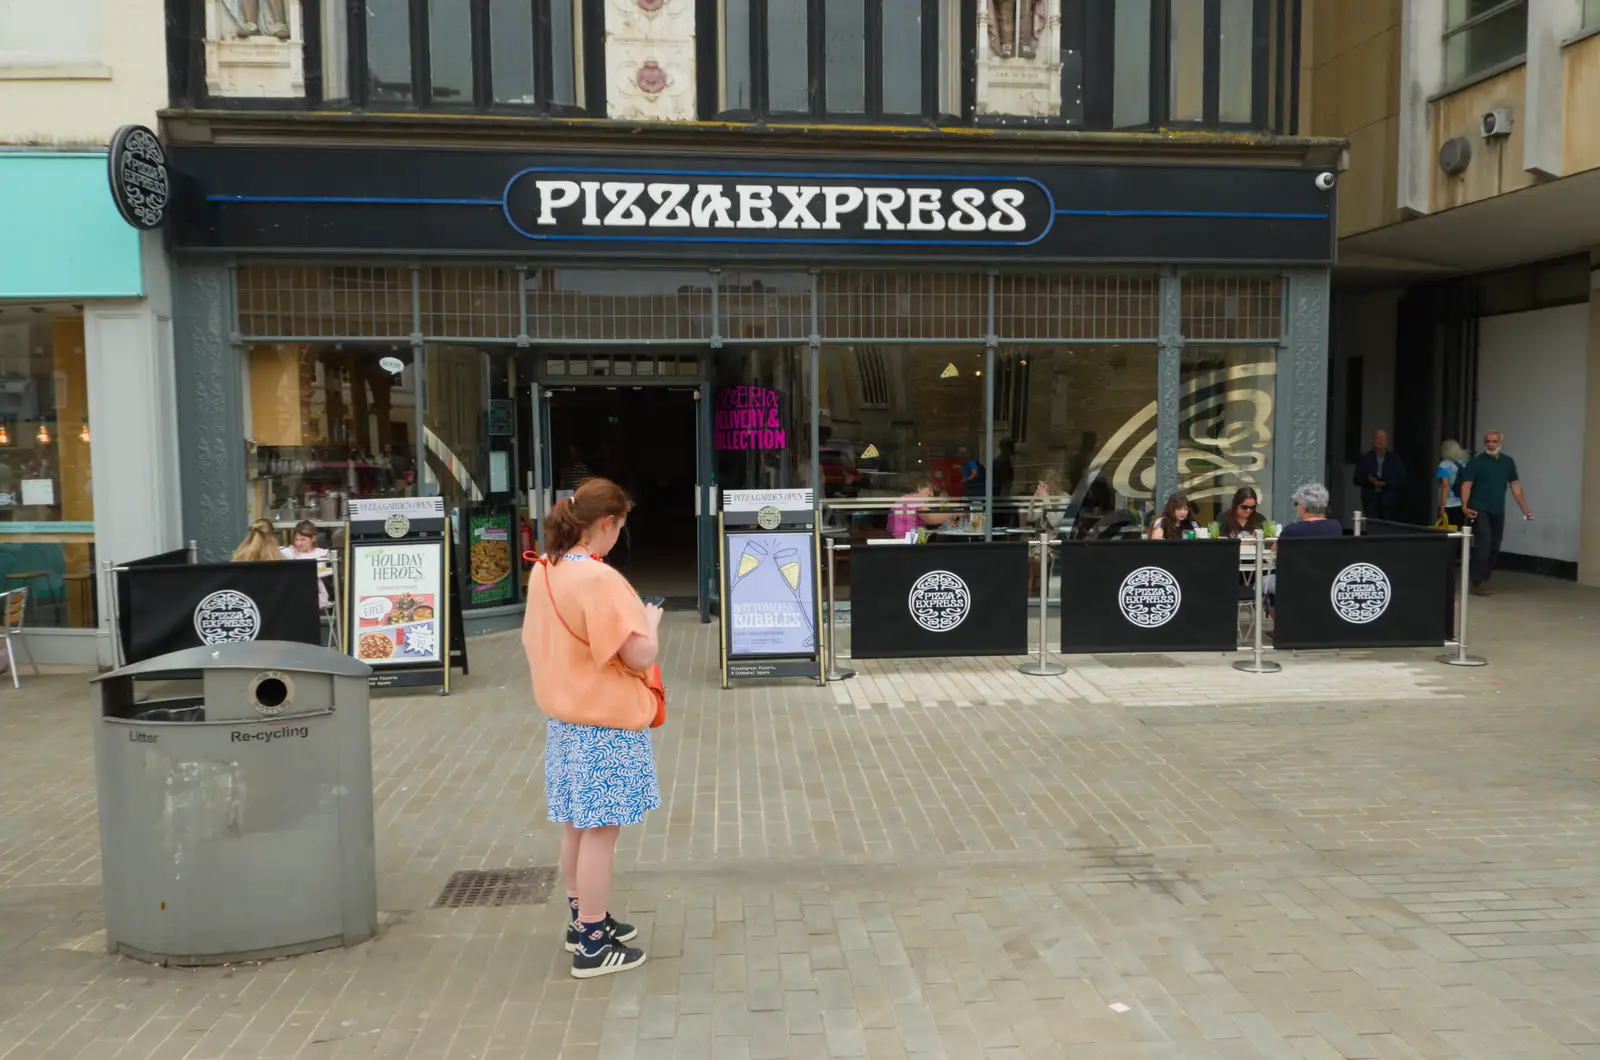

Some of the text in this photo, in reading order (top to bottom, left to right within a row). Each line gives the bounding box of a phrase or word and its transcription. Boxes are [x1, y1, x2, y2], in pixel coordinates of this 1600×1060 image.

[535, 180, 1027, 232] PIZZAEXPRESS
[767, 407, 780, 428] &
[733, 492, 803, 502] PIZZA GARDEN OPEN
[360, 503, 382, 511] PIZZA
[382, 502, 412, 511] GARDEN
[413, 501, 433, 509] OPEN
[371, 553, 424, 567] HOLIDAY
[373, 567, 423, 580] HEROES
[1134, 588, 1166, 596] PIZZA
[1346, 584, 1376, 592] PIZZA
[924, 591, 955, 600] PIZZA
[1125, 595, 1174, 604] EXPRESS
[1337, 591, 1385, 600] EXPRESS
[734, 602, 794, 613] BOTTOMLESS
[915, 599, 964, 608] EXPRESS
[211, 611, 244, 620] PIZZA
[733, 612, 801, 629] BUBBLES
[202, 619, 253, 628] EXPRESS
[129, 731, 159, 744] Litter
[230, 725, 309, 744] Re-cycling
